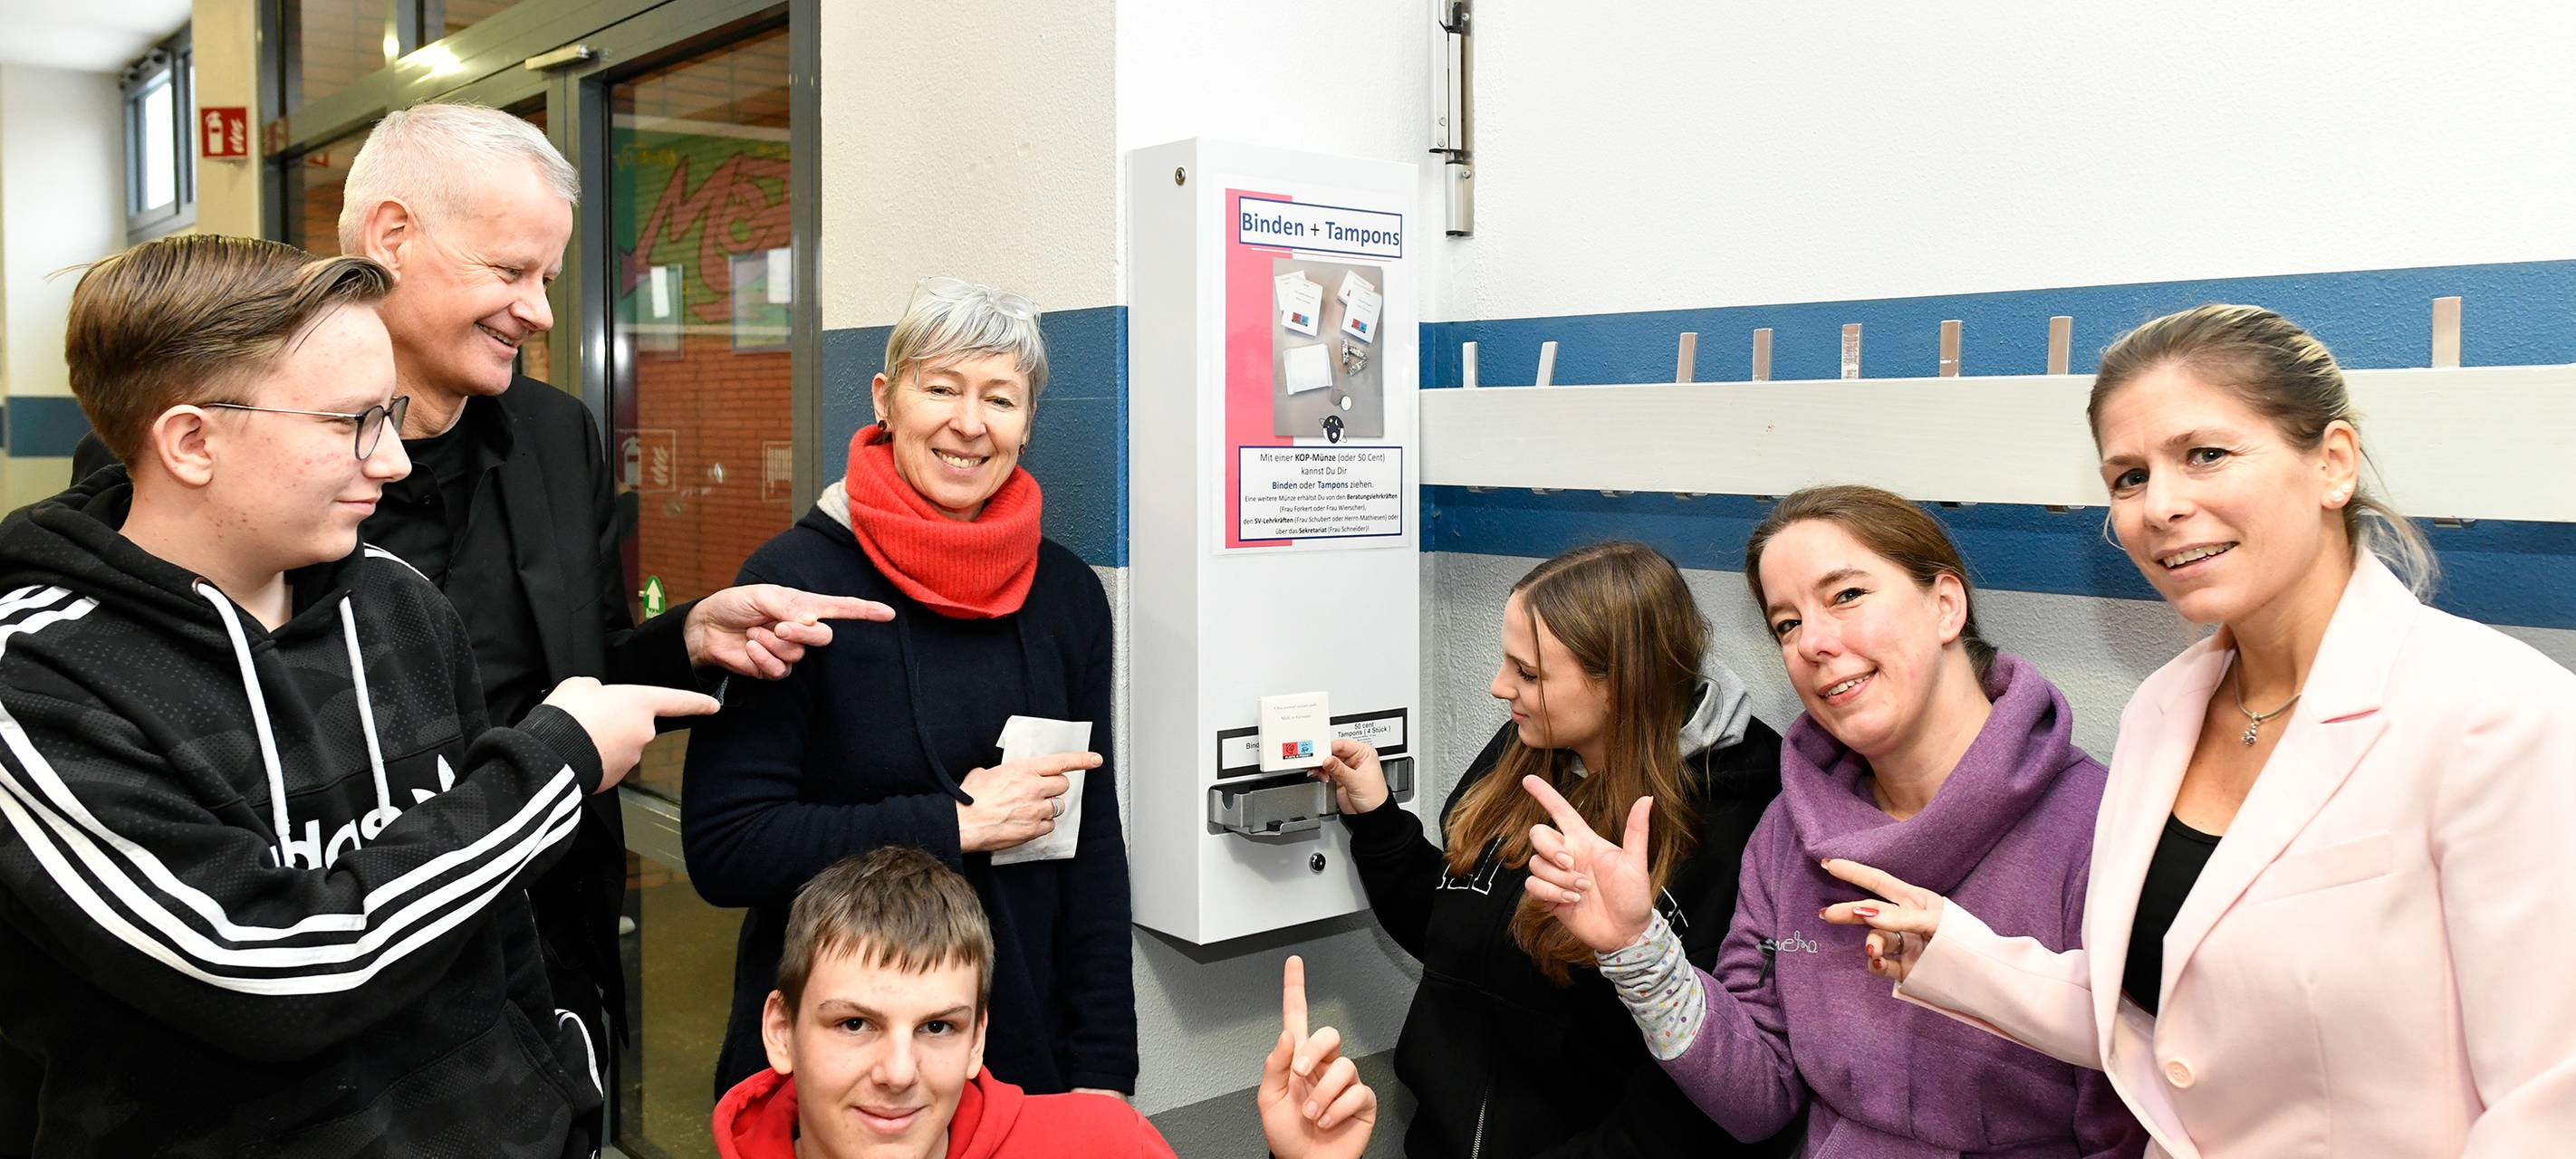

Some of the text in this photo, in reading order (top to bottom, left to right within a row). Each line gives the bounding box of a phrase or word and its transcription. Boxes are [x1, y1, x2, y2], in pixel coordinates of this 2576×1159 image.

[1242, 212, 1399, 246] Binden + Tampons
[1260, 454, 1274, 462] Mit
[1295, 454, 1336, 462] KOP-Münze
[1338, 454, 1356, 463] (oder
[1358, 454, 1366, 462] 50
[1368, 454, 1386, 463] Cent)
[1301, 467, 1347, 475] kannst Du Dir
[1272, 481, 1374, 490] Binden oder Tampons ziehen.
[1346, 493, 1398, 501] Beratungslehrkräften
[1279, 505, 1293, 513] (Frau
[1362, 721, 1375, 729] cent
[1338, 730, 1363, 738] Tampons
[1372, 725, 1387, 733] Stück
[1245, 742, 1260, 750] Bind
